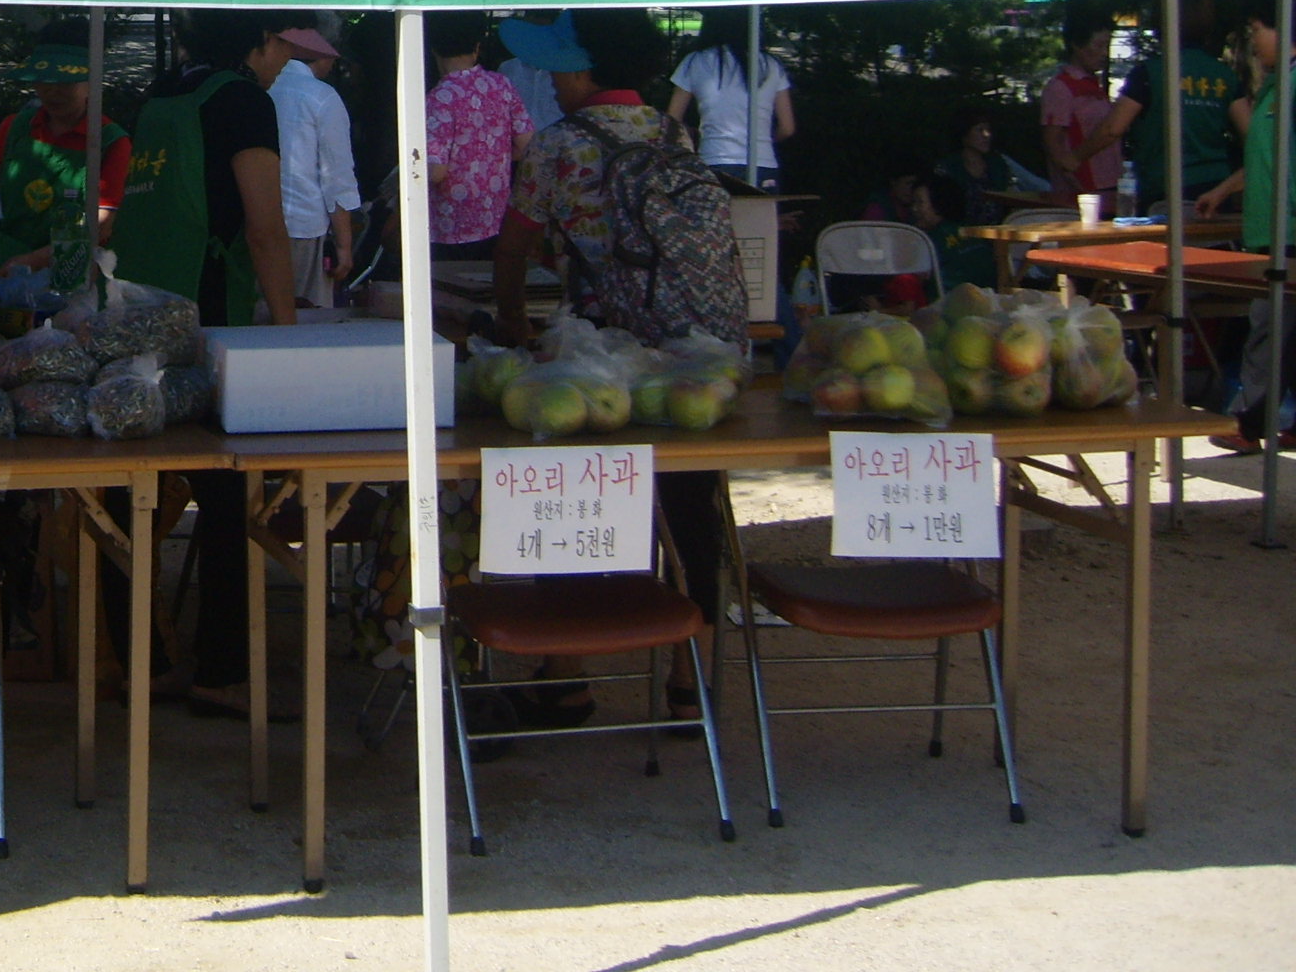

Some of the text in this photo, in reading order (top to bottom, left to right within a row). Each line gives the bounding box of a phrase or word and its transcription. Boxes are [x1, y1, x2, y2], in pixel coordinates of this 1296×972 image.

[495, 452, 640, 497] 아오리 사과
[844, 439, 982, 482] 아오리 사과
[517, 526, 616, 560] 4개 5천원
[867, 511, 964, 544] 8개 1만원
